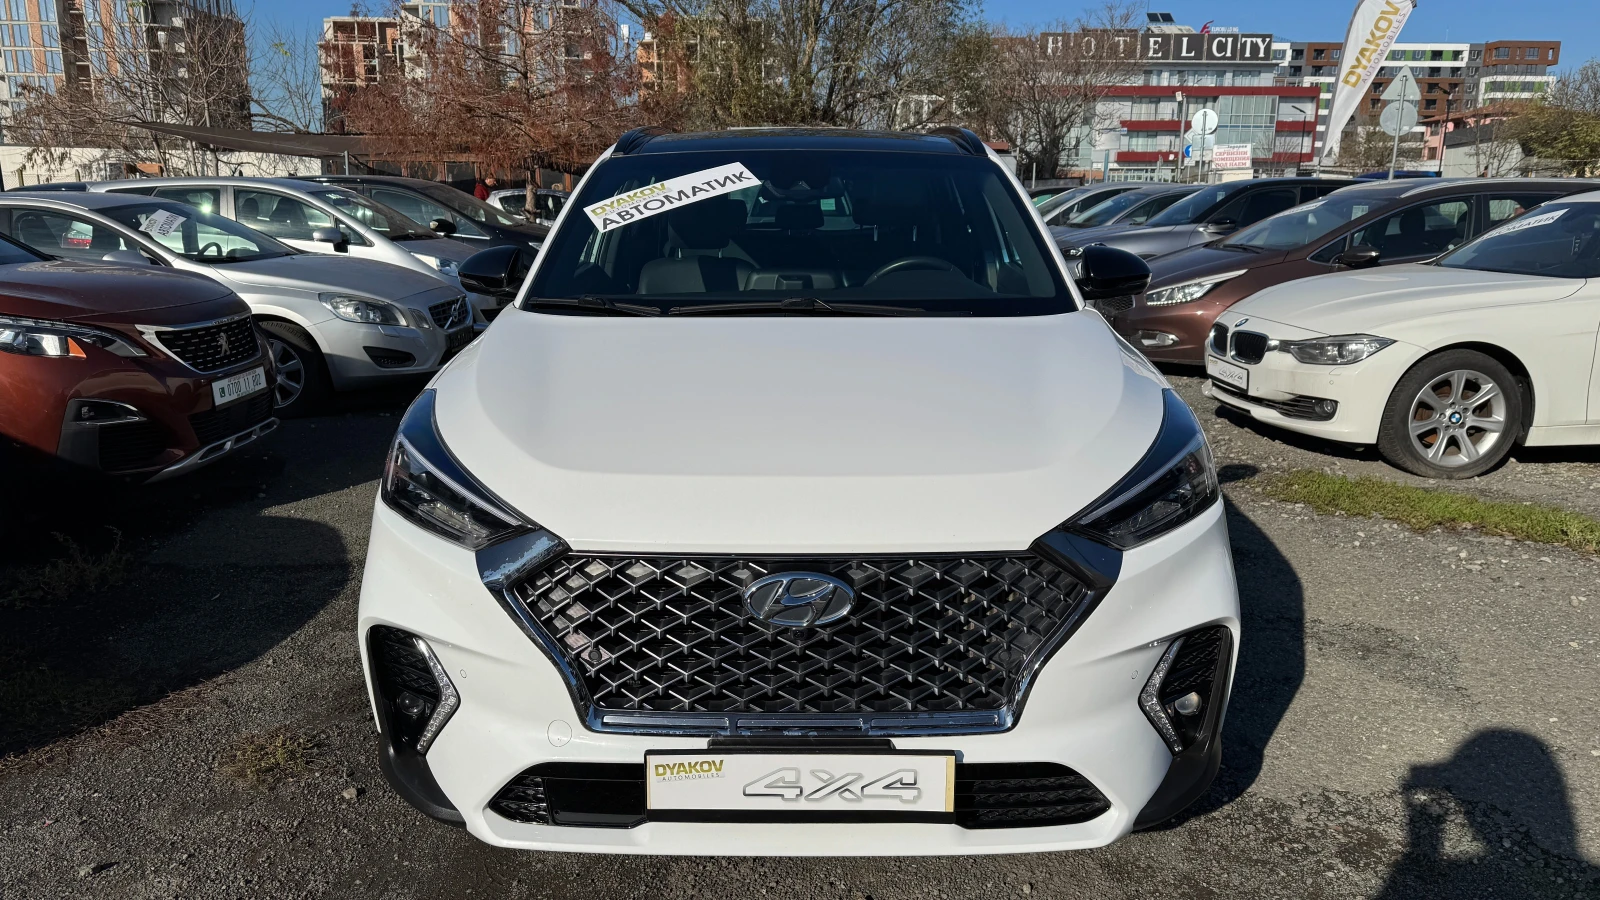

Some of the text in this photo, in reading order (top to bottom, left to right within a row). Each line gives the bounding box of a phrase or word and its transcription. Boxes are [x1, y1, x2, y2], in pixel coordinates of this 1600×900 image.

[1047, 36, 1270, 57] HOTEL CITY
[1342, 0, 1401, 89] DYAKOV
[1361, 12, 1406, 84] AUTOMOBILES
[591, 183, 666, 217] DYAKOV
[602, 171, 753, 231] АВТОМАТИК
[654, 759, 724, 776] DYAKOV
[661, 773, 720, 781] AUTOMOBILES
